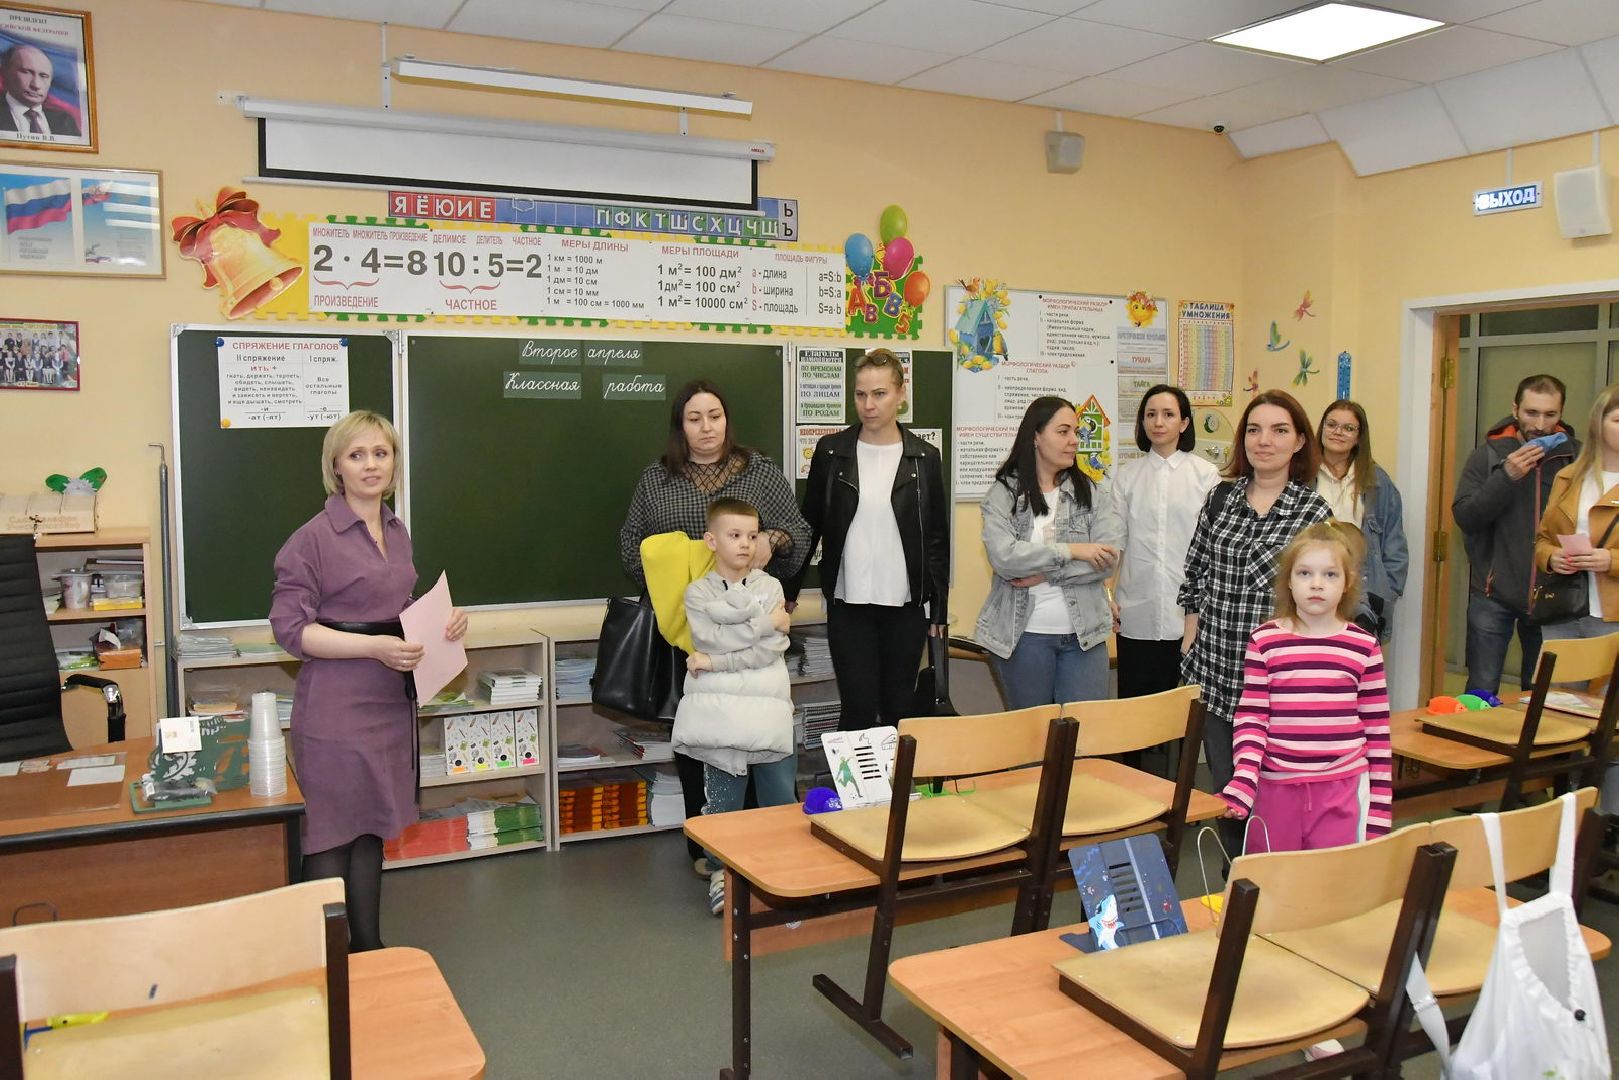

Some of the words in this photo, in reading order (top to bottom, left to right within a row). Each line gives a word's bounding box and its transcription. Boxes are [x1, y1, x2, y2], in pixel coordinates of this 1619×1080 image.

[1476, 188, 1535, 210] ВЫХОД
[784, 203, 794, 218] Ь
[782, 222, 794, 236] Ъ
[312, 228, 350, 238] МНОЖИТЕЛЬ
[352, 230, 388, 240] МНОЖИТЕЛЬ
[389, 231, 428, 242] ПРОИЗВЕДЕНИЕ
[433, 234, 466, 244] ДЕЛИМОЕ
[476, 234, 504, 245] ДЕЛИТЕЛЬ
[512, 236, 542, 246] ЧАСТНОЕ
[561, 239, 591, 251] МЕРЫ
[592, 240, 629, 253] ДЛИНЫ
[314, 244, 333, 272] 2
[661, 246, 690, 256] МЕРЫ
[692, 248, 739, 260] ПЛОЩАДИ
[774, 253, 804, 264] ПЛОЩАДЬ
[804, 254, 828, 264] ФИГУРЫ
[574, 255, 593, 264] 1000
[574, 266, 584, 274] 10
[586, 268, 599, 276] дм
[696, 265, 716, 278] 100
[719, 266, 742, 279] дм²
[763, 269, 788, 280] длина
[574, 277, 584, 285] 10
[696, 280, 716, 293] 100
[720, 282, 741, 294] см²
[574, 288, 584, 296] 10
[763, 286, 794, 298] ширина
[314, 295, 378, 308] ПРОИЗВЕДЕНИЕ
[445, 299, 497, 310] ЧАСТНОЕ
[574, 298, 589, 306] 100
[611, 300, 630, 308] 1000
[632, 302, 644, 310] мм
[695, 297, 727, 310] 10000
[729, 297, 748, 310] см²
[1189, 302, 1224, 311] ТАБЛИЦА
[762, 302, 798, 314] площадь
[1181, 311, 1230, 320] УМНОЖЕНИЯ
[232, 342, 290, 350] СПРЯЖЕНИЕ
[293, 343, 339, 351] ГЛАГОЛОВ
[243, 355, 286, 363] спряжение
[522, 340, 578, 364] Второе
[587, 347, 641, 366] апреля
[505, 372, 580, 391] Классная
[604, 375, 665, 400] работа
